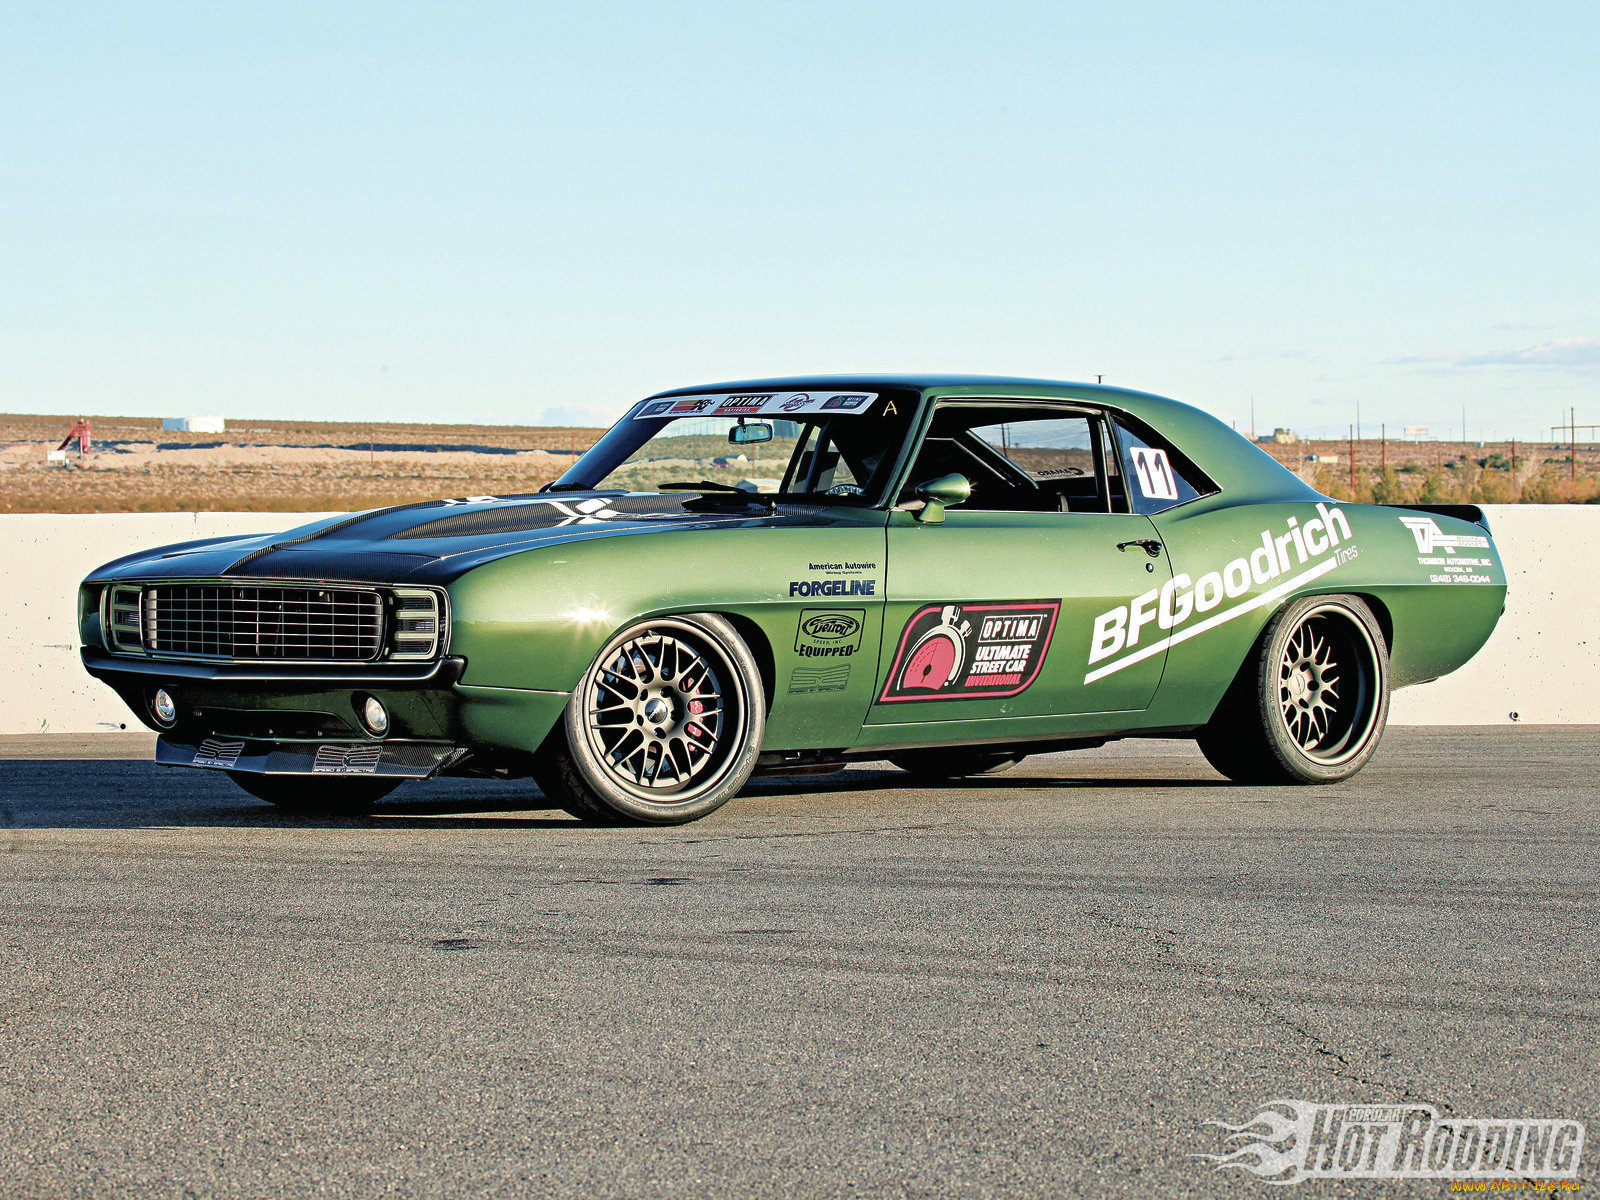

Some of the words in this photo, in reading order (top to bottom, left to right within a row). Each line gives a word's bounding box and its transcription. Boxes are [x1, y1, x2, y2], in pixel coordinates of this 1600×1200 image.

[722, 396, 769, 407] OPTIMA
[882, 400, 898, 417] A
[1136, 451, 1173, 496] 11
[808, 562, 843, 571] American
[845, 561, 876, 570] Autowire
[789, 579, 876, 598] FORGELINE
[1088, 503, 1353, 665] BFGoodrich
[1335, 545, 1358, 567] Tires
[982, 619, 1037, 639] OPTIMA
[799, 644, 855, 658] EQUIPPED
[975, 644, 1032, 661] ULTIMATE
[970, 660, 1005, 674] STREET
[1005, 660, 1027, 673] CAR
[964, 673, 1022, 687] INVITATIONAL
